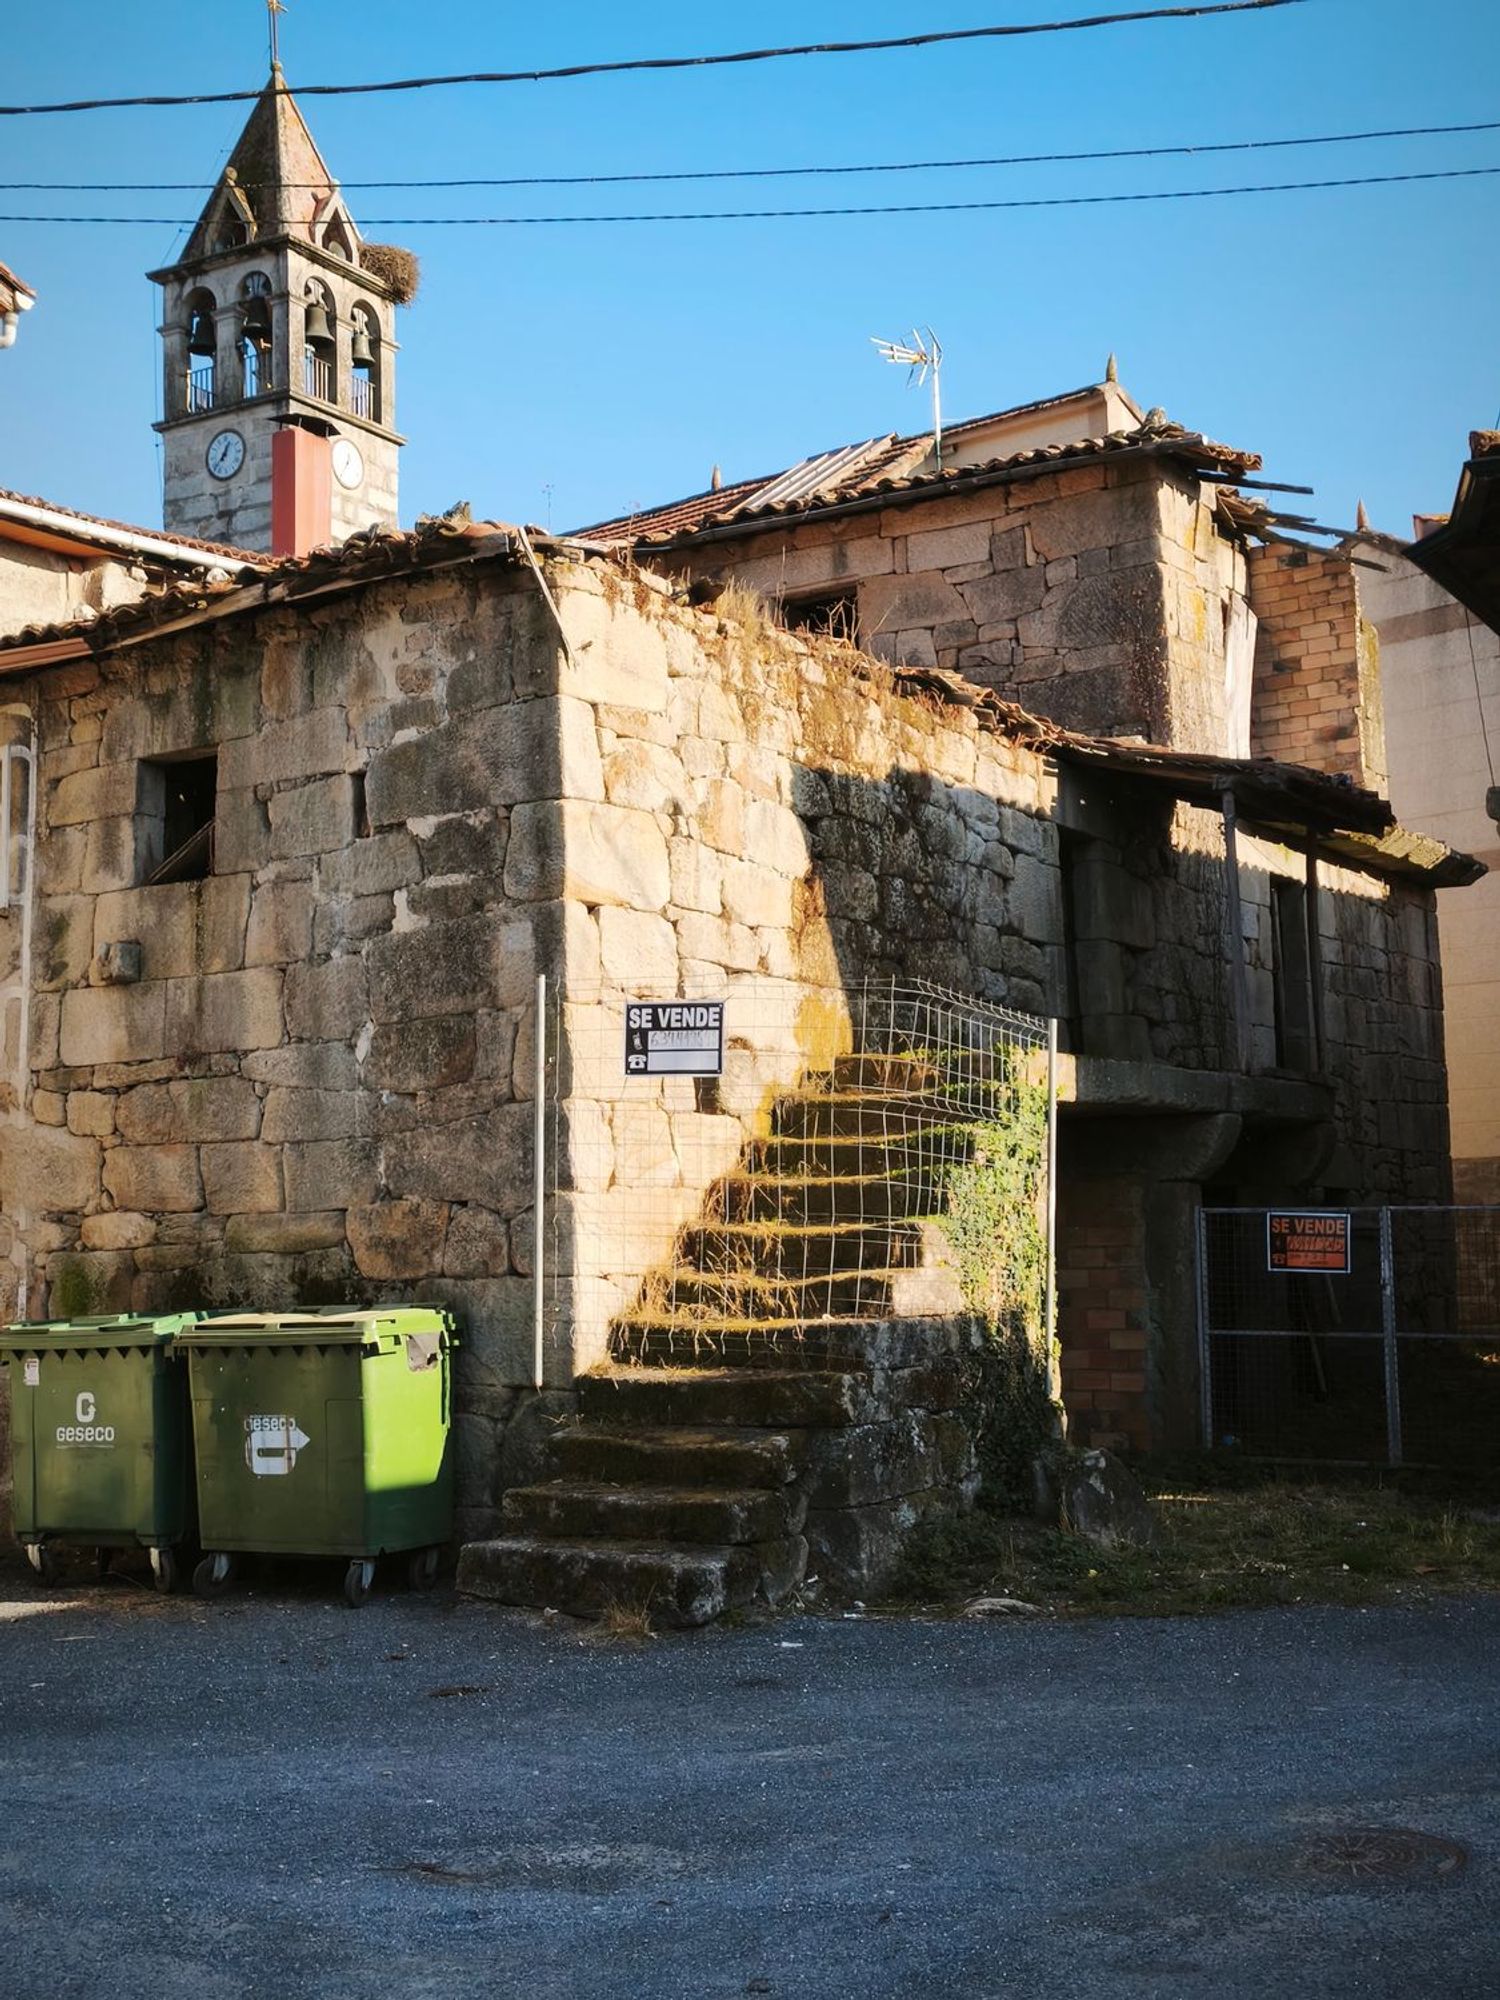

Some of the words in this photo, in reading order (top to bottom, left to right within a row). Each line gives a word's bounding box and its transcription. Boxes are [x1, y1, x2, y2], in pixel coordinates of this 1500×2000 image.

[629, 1008, 652, 1029] SE
[657, 1006, 720, 1028] VENDE
[1271, 1217, 1290, 1233] SE
[1294, 1218, 1345, 1234] VENDE
